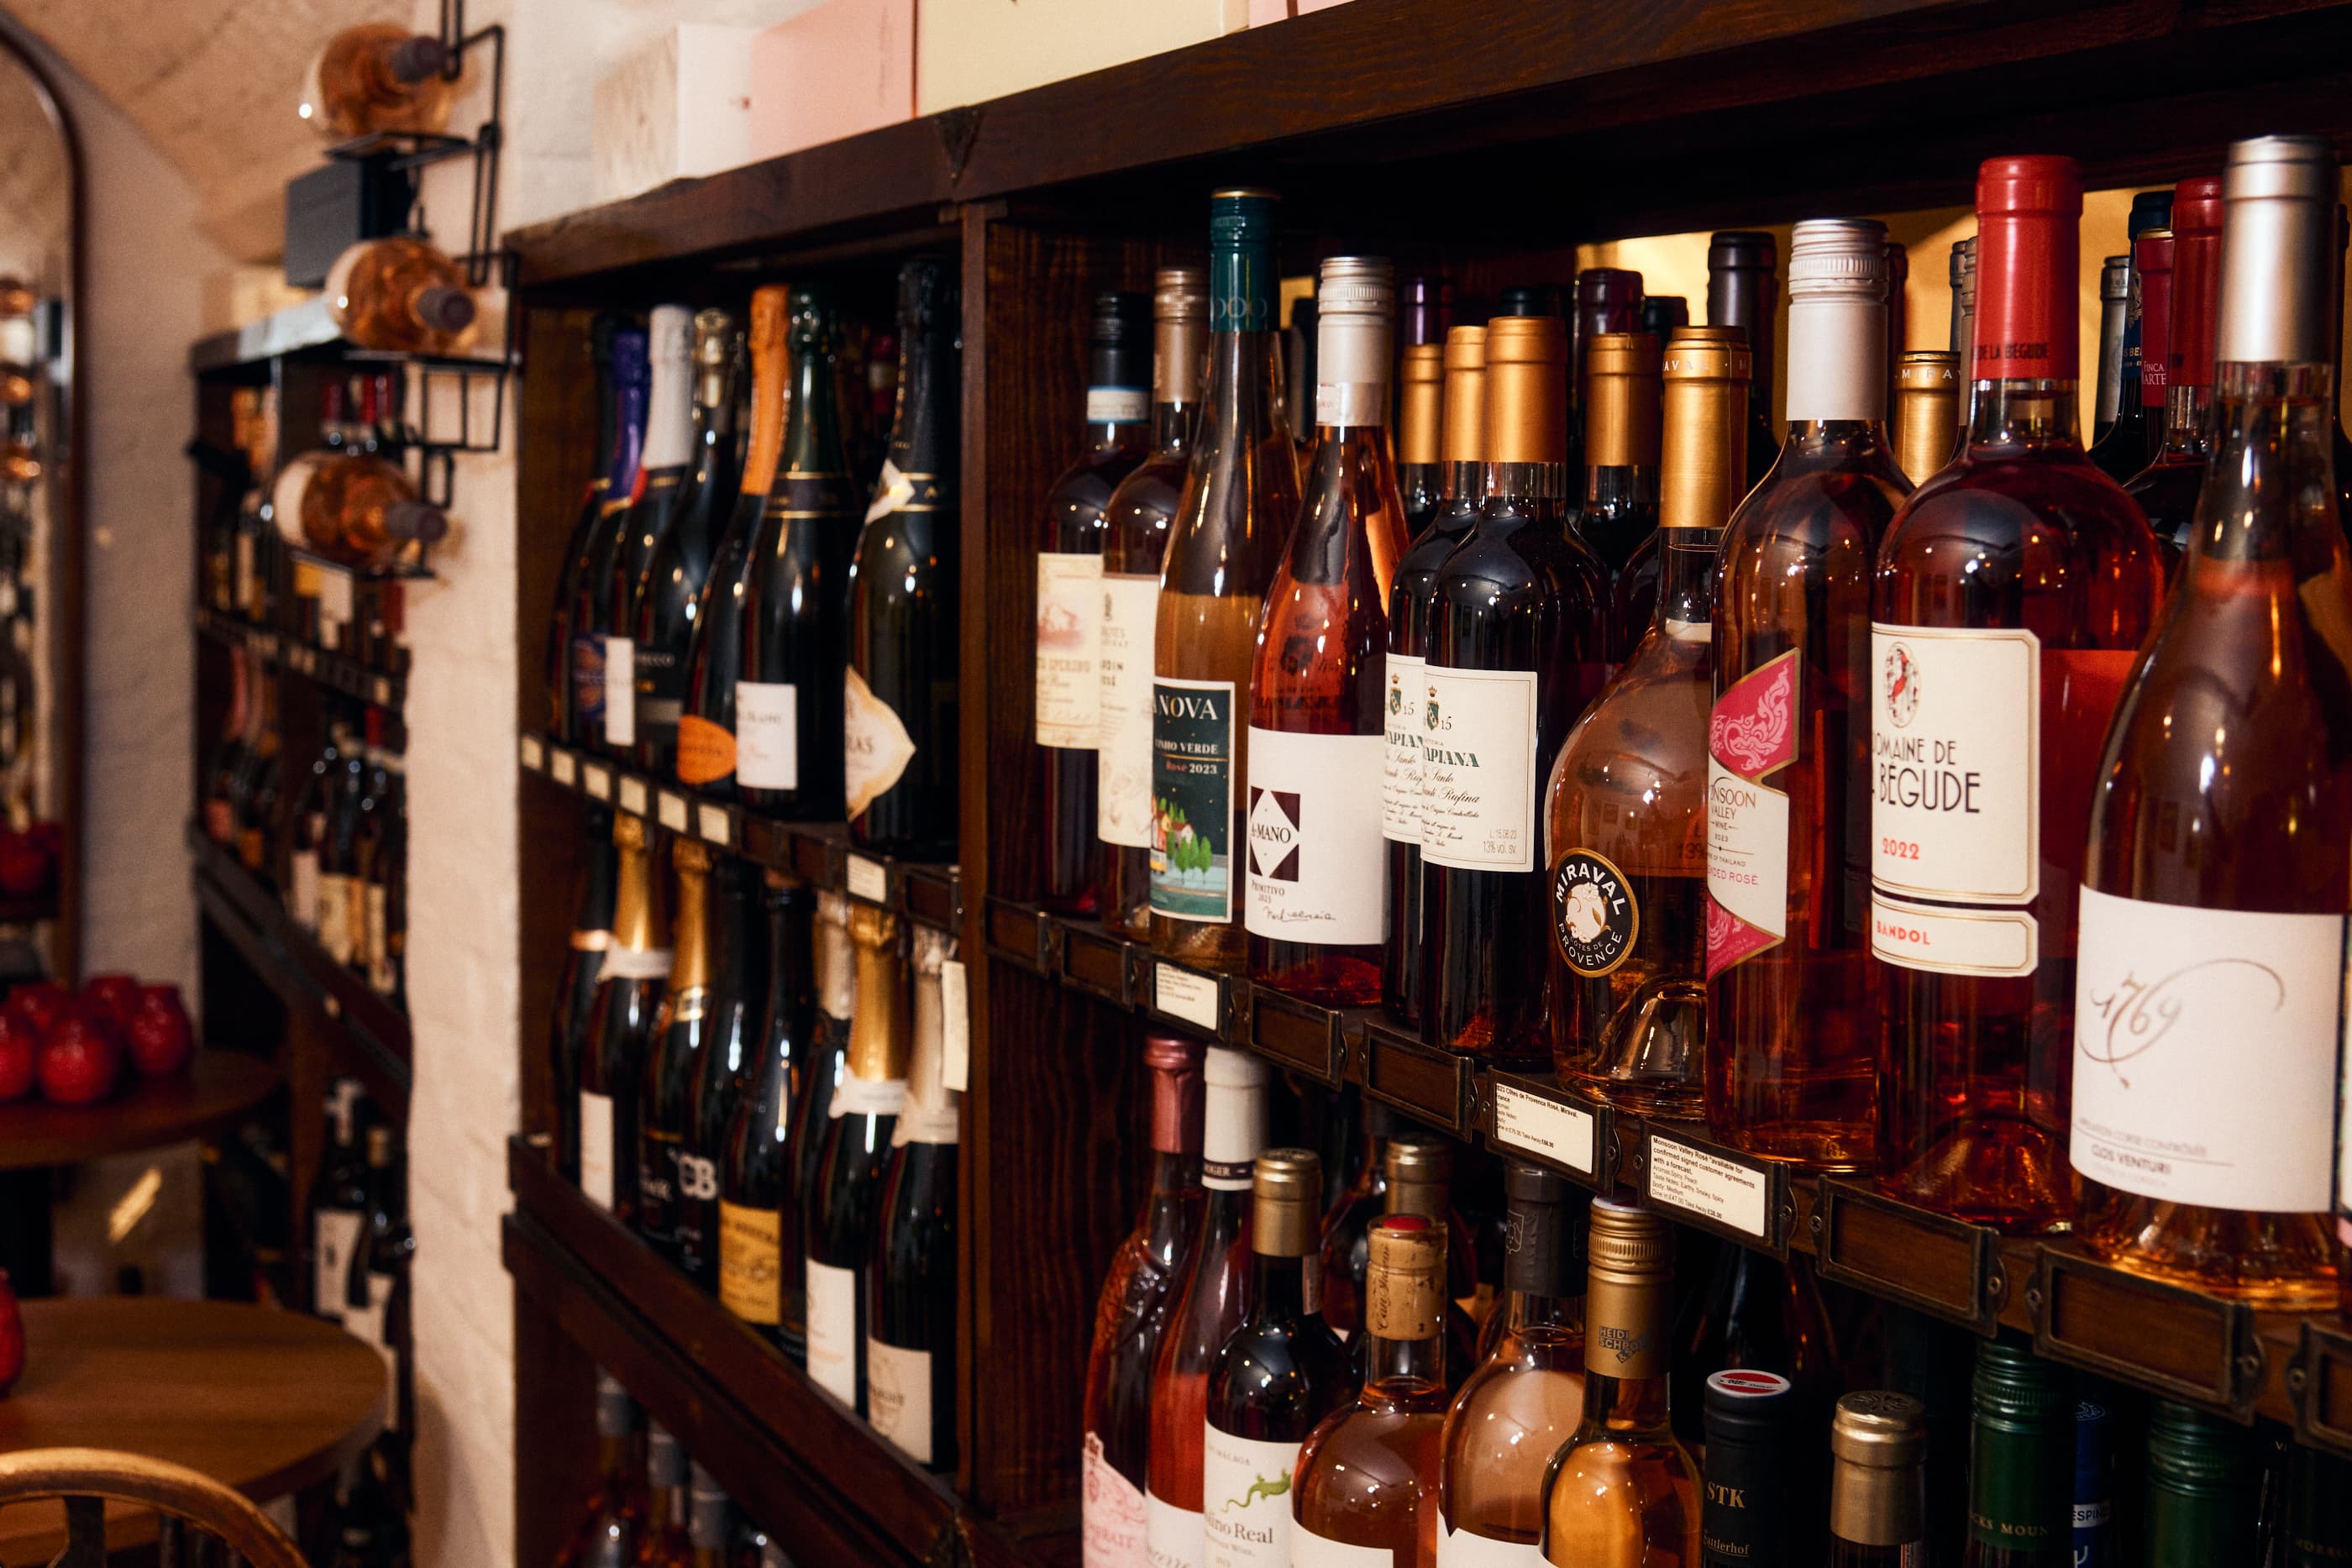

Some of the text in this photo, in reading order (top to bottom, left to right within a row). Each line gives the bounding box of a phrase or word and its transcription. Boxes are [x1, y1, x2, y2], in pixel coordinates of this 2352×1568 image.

[2143, 373, 2167, 385] ARTE
[1179, 742, 1219, 755] VERDE
[1935, 740, 1956, 765] DE
[1189, 763, 1218, 774] 2023
[1438, 786, 1480, 806] Rufina
[1882, 836, 1920, 860] 2022
[1556, 863, 1626, 915] MIRAVAL
[1729, 871, 1759, 886] ROSÉ
[1877, 920, 1930, 946] BANDOL
[1558, 923, 1623, 967] PROVENCE
[1525, 1094, 1546, 1107] Provence
[1653, 1137, 1678, 1151] Monsoon
[1679, 1146, 1694, 1157] Valley
[1735, 1165, 1744, 1175] for
[1653, 1156, 1666, 1166] with
[1653, 1147, 1756, 1189] confirmed signed customer agreements
[1599, 1326, 1630, 1339] HEIDI
[1707, 1481, 1746, 1508] STK
[1234, 1523, 1273, 1544] Real
